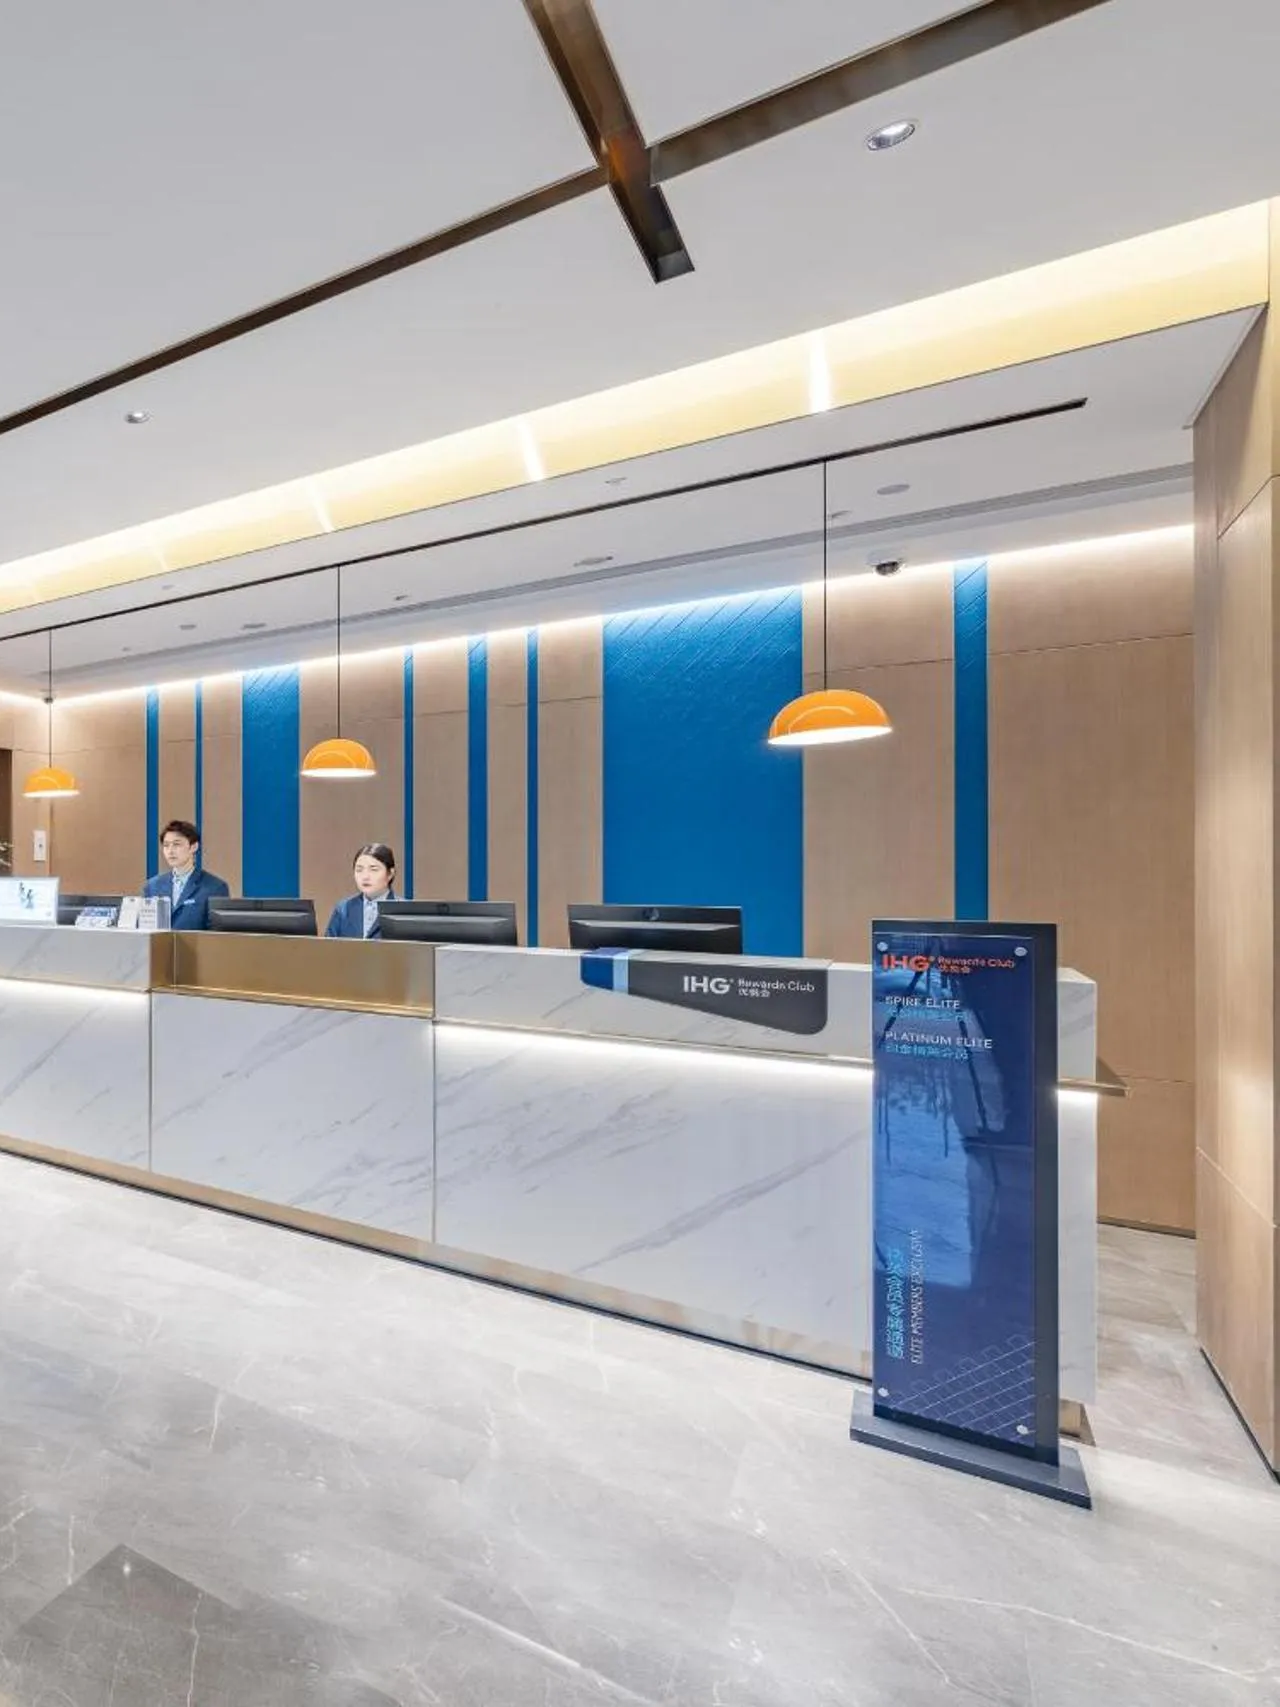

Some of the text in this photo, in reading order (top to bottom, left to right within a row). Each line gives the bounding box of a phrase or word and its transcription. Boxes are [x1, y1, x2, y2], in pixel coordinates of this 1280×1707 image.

[881, 953, 1016, 972] IHG Rewards Club
[683, 975, 815, 995] IHG Rewards Club
[884, 995, 961, 1009] SPIRE ELITE
[884, 1031, 993, 1049] PLATINUM ELITE
